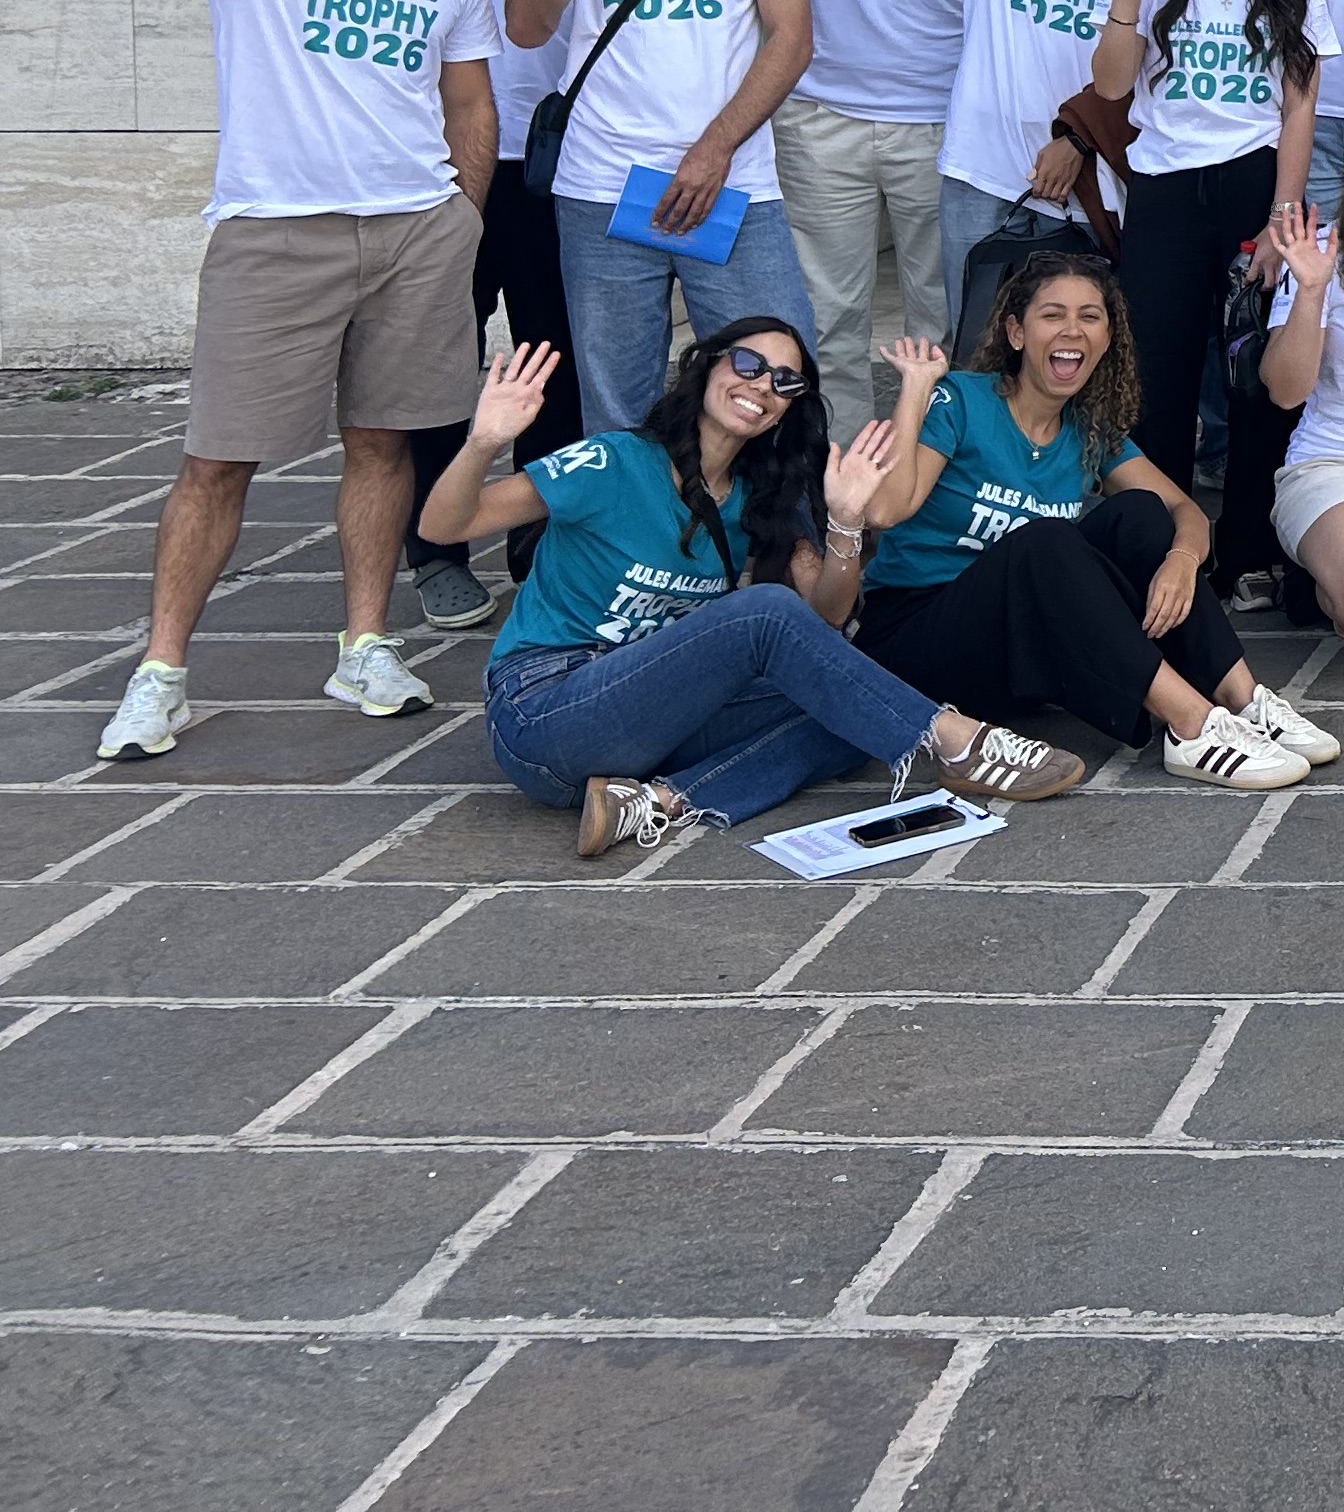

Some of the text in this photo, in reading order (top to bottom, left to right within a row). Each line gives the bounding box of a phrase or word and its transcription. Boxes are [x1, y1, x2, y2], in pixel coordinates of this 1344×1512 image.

[303, 21, 427, 72] 2026
[1165, 71, 1272, 104] 2026
[976, 482, 1021, 508] JULES
[625, 562, 671, 590] JULES
